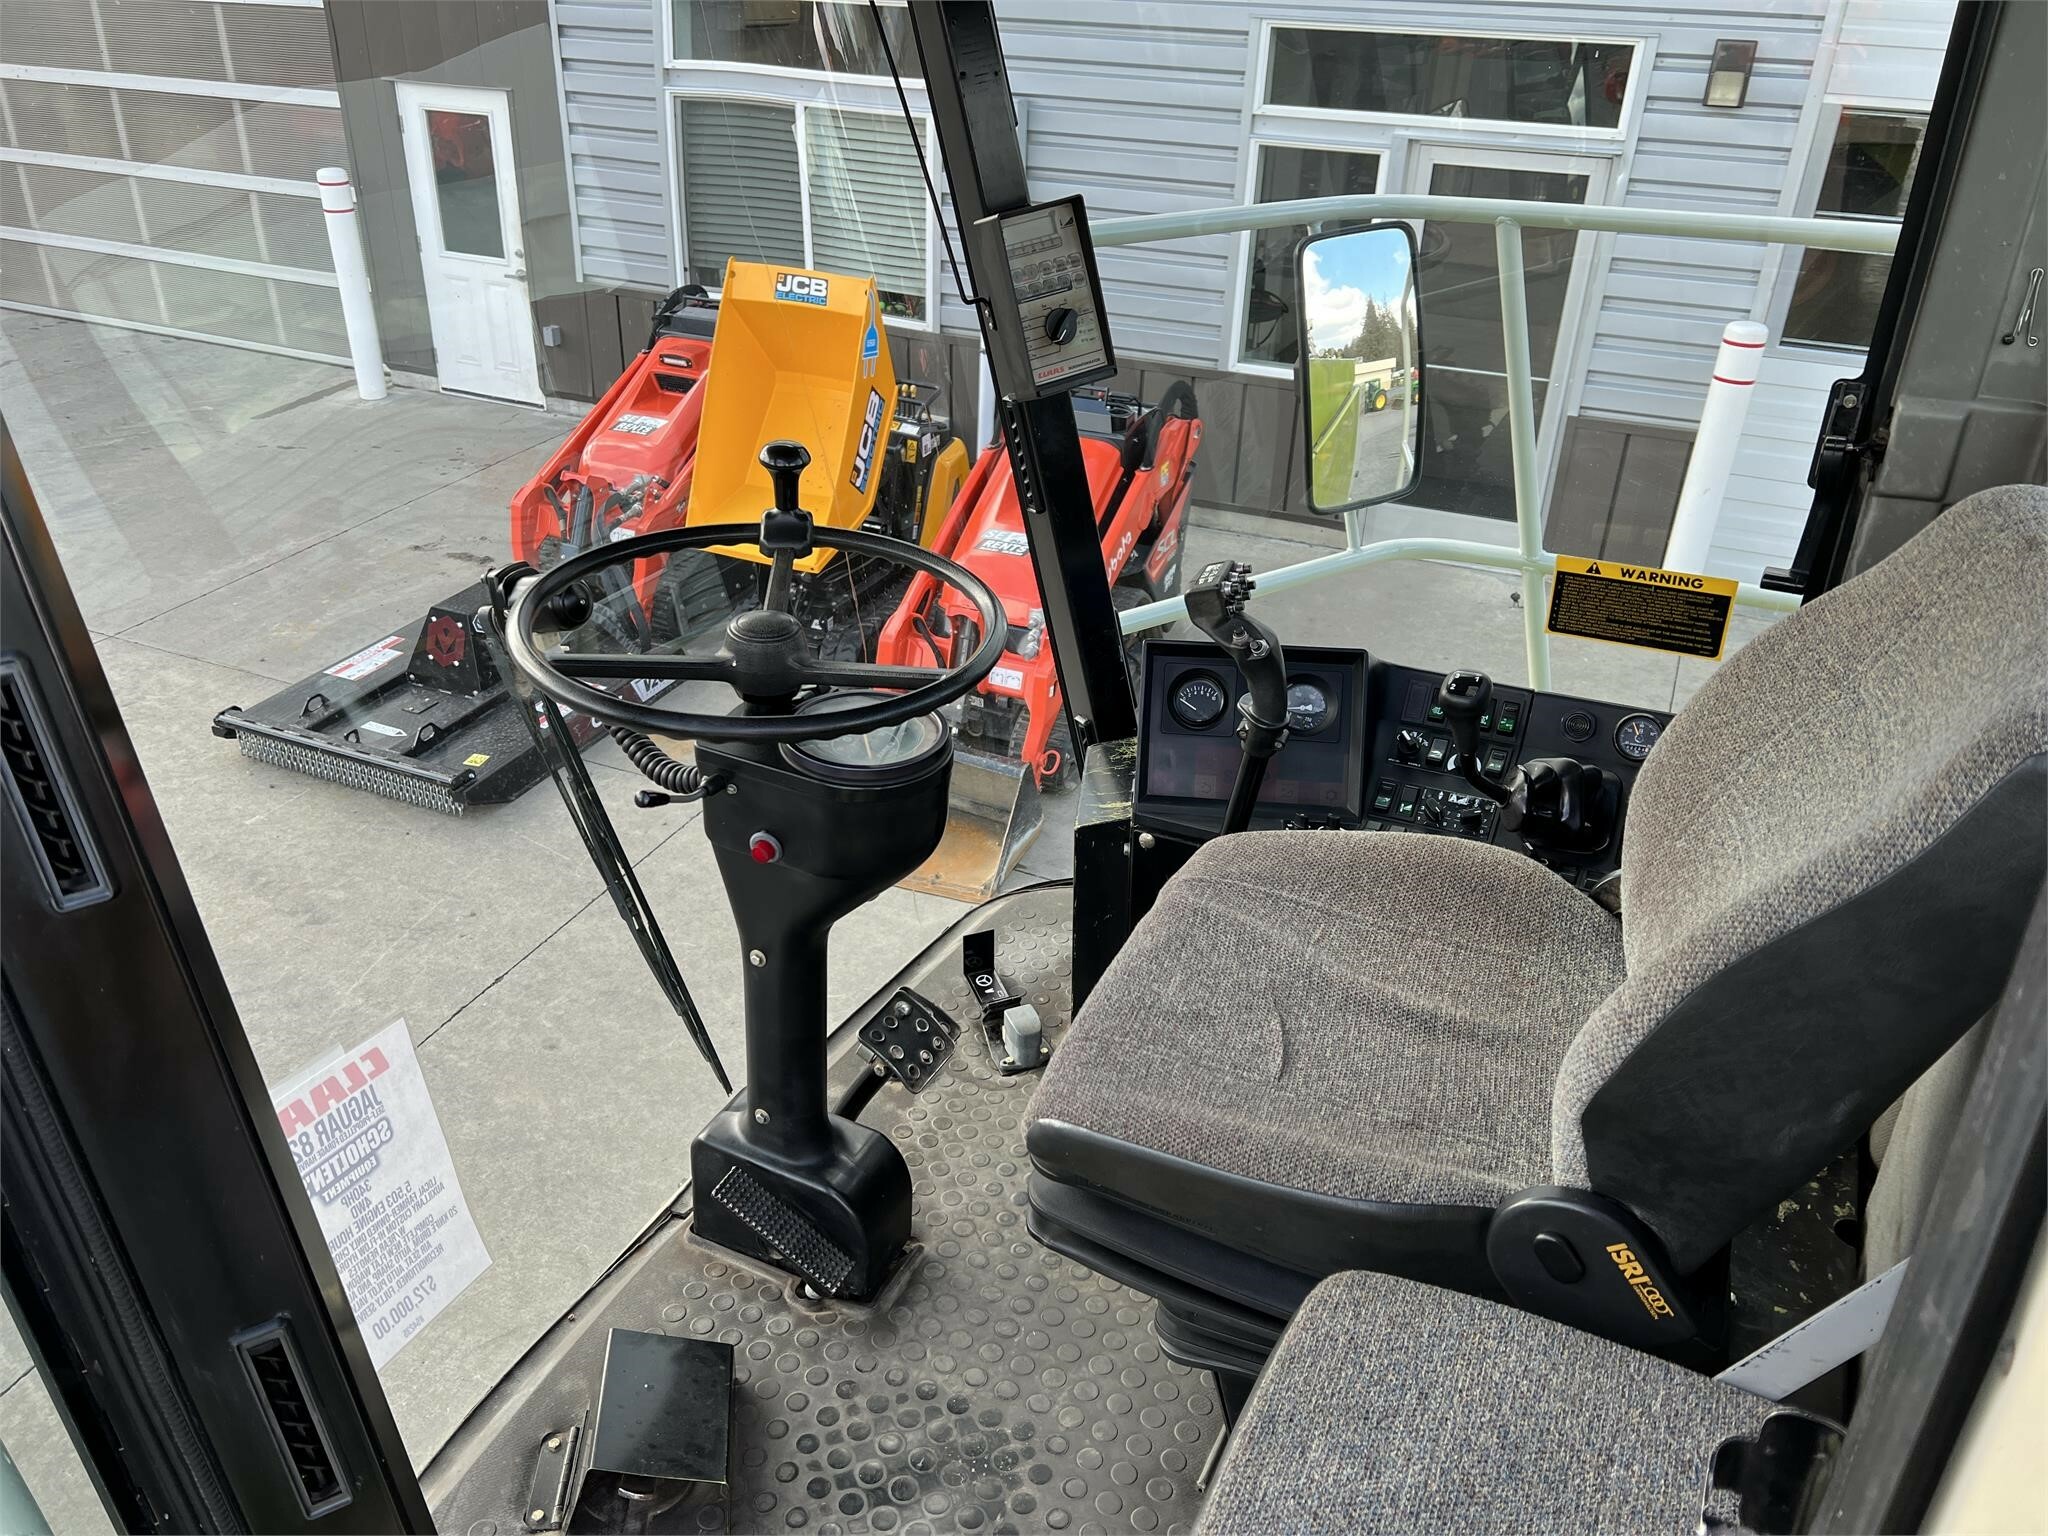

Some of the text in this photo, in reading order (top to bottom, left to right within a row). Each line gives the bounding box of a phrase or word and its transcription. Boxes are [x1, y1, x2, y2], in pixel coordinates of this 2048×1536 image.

[776, 274, 827, 297] JCB
[775, 291, 827, 305] ELECTRIC
[613, 422, 652, 434] RENTS
[855, 390, 880, 487] JCB
[983, 540, 1028, 553] RENTS
[1620, 567, 1704, 589] WARNING
[1605, 1242, 1651, 1285] ISRI
